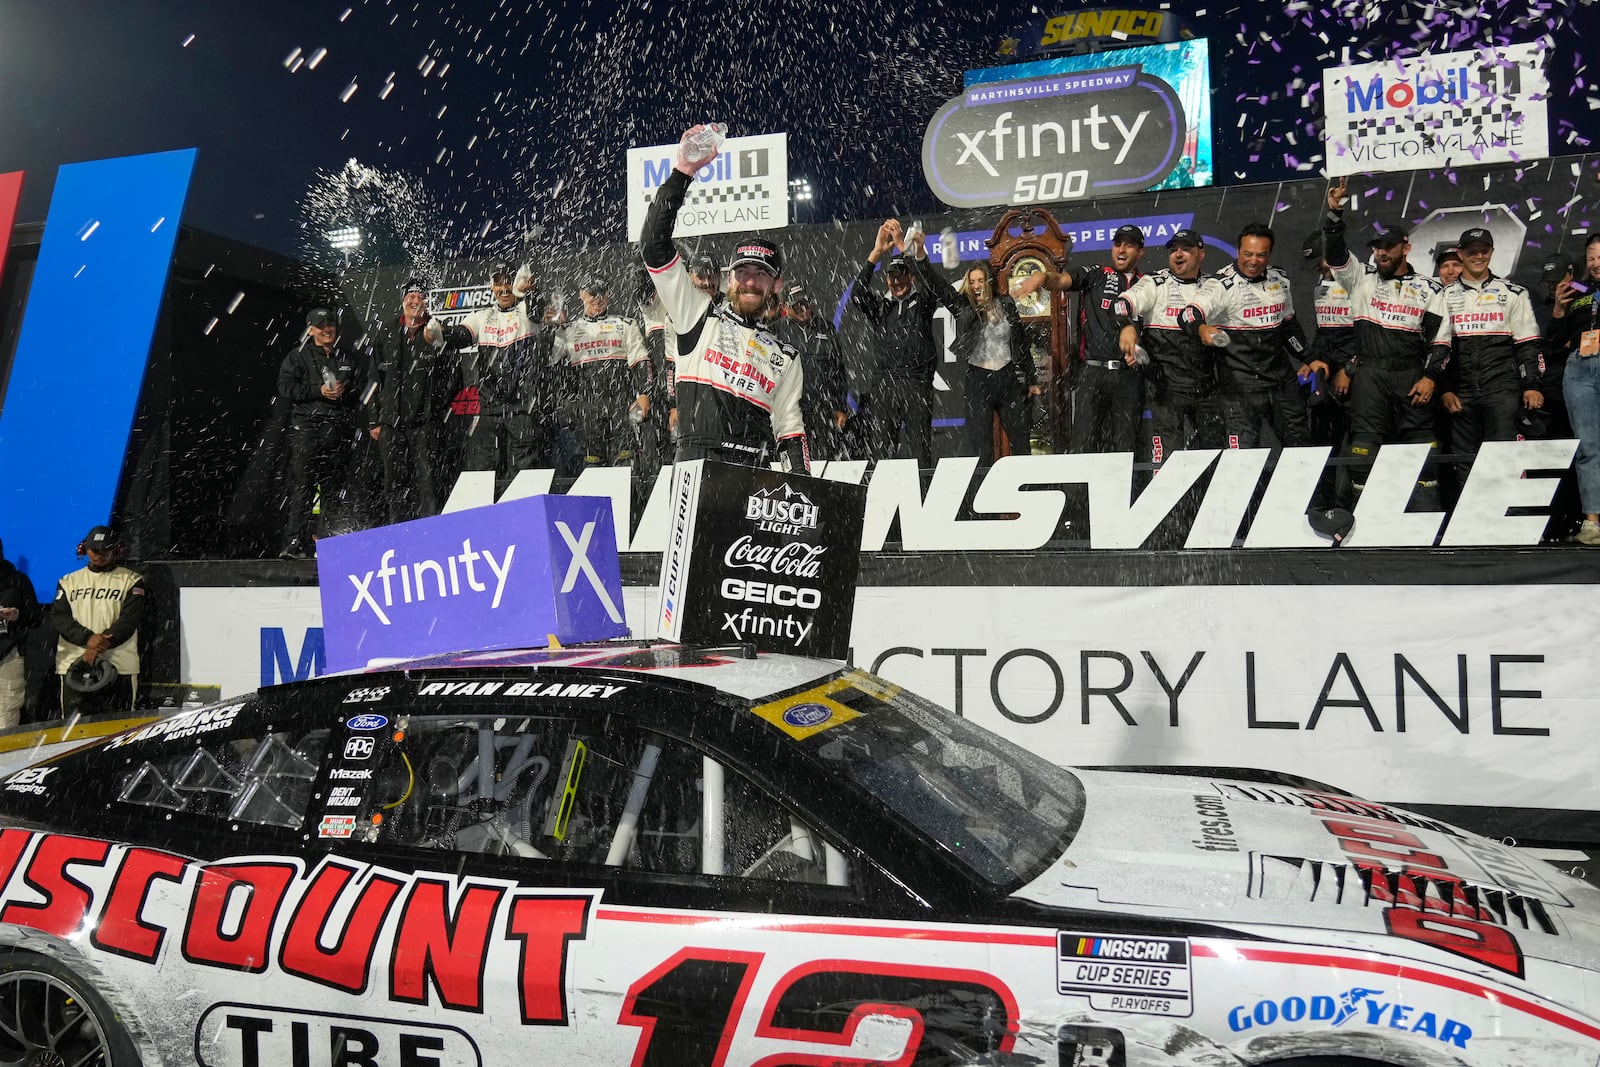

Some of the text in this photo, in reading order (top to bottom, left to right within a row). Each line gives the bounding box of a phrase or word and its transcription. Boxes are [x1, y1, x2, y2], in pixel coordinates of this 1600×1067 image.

[1040, 9, 1165, 46] SUNOCO
[971, 74, 1131, 102] MARTINSVILLE SPEEDWAY
[1347, 67, 1468, 113] Mobil
[955, 104, 1150, 177] xfinity
[1350, 129, 1523, 162] VICTORY LANE
[644, 151, 732, 188] Mbil
[1013, 170, 1089, 203] 500
[677, 205, 770, 228] TORY LANE
[1068, 222, 1183, 244] SPEWAY
[463, 289, 498, 307] NASC
[1370, 297, 1425, 318] DISCOUNT
[1243, 302, 1286, 318] DISCOU
[1259, 313, 1281, 323] TIRE
[1381, 312, 1407, 322] TIRE
[573, 339, 623, 352] DISCOUNT
[703, 347, 776, 395] DISCOUNT
[722, 370, 757, 392] TIRE
[439, 439, 1580, 554] NSVILLE
[745, 495, 820, 529] BUSCH
[668, 470, 691, 597] CUP SERIES
[759, 522, 802, 536] LIGHT
[724, 535, 828, 579] Coca-Cola
[348, 538, 516, 625] xfinity
[721, 578, 821, 610] GEICO
[721, 607, 813, 646] xfinity
[418, 682, 628, 699] RYAN BLANEY
[850, 645, 1551, 737] TORY LANE
[132, 702, 248, 744] ADVANCE
[351, 715, 383, 728] Ford
[787, 705, 829, 725] Ford
[163, 718, 234, 742] AUTO PARTS
[345, 738, 373, 757] PPG
[4, 767, 60, 785] DEX
[329, 768, 374, 780] Mazak
[326, 796, 362, 807] WIZARD
[330, 786, 355, 797] DENT
[1191, 794, 1240, 852] tires.com
[0, 829, 591, 1027] SCOUNT
[1098, 938, 1170, 961] NASCAR
[1076, 964, 1172, 987] CUP SERIES
[1110, 996, 1171, 1012] PLAYOFFS
[1227, 994, 1473, 1051] GOODYEAR
